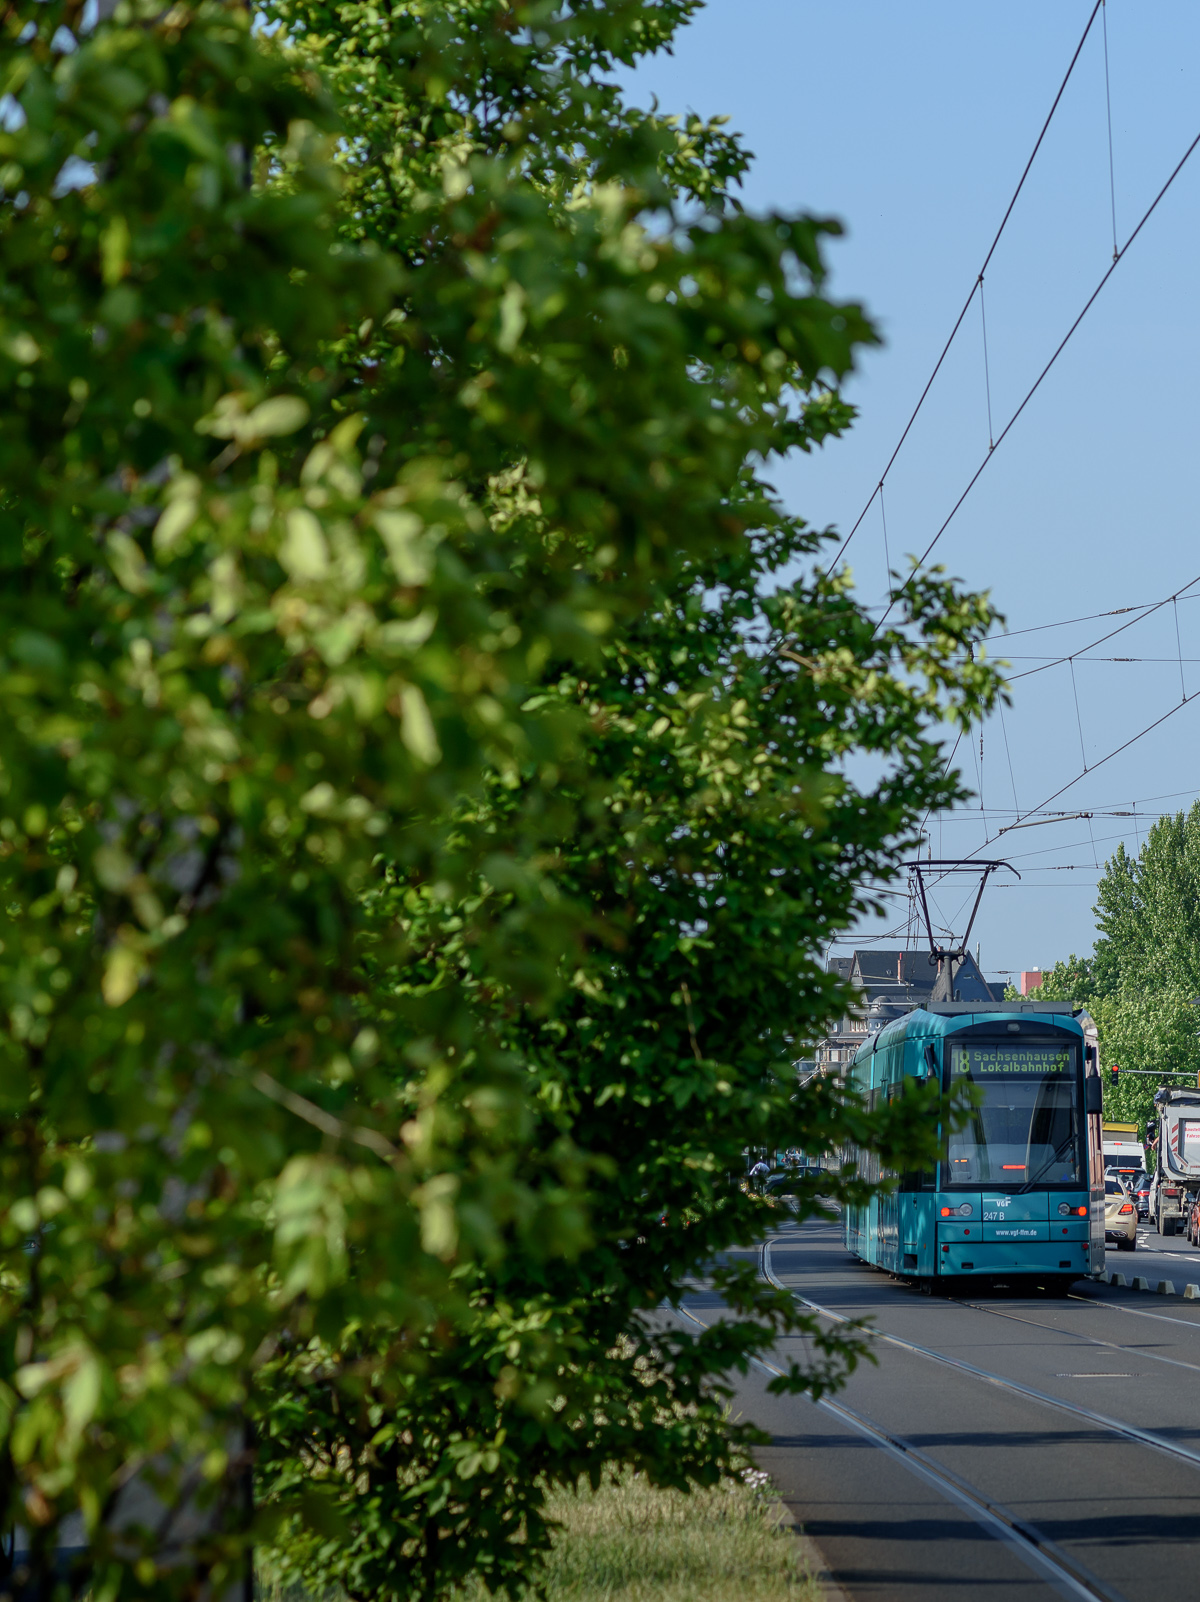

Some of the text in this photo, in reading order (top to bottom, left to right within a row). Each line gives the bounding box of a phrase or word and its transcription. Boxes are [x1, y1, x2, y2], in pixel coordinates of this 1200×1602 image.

[952, 1048, 970, 1073] 18
[974, 1051, 1070, 1062] Sachsenhausen
[980, 1061, 1065, 1072] Lokalbahnhof
[984, 1212, 1004, 1220] 247 B
[995, 1229, 1037, 1237] www.vgf-ffm.de
